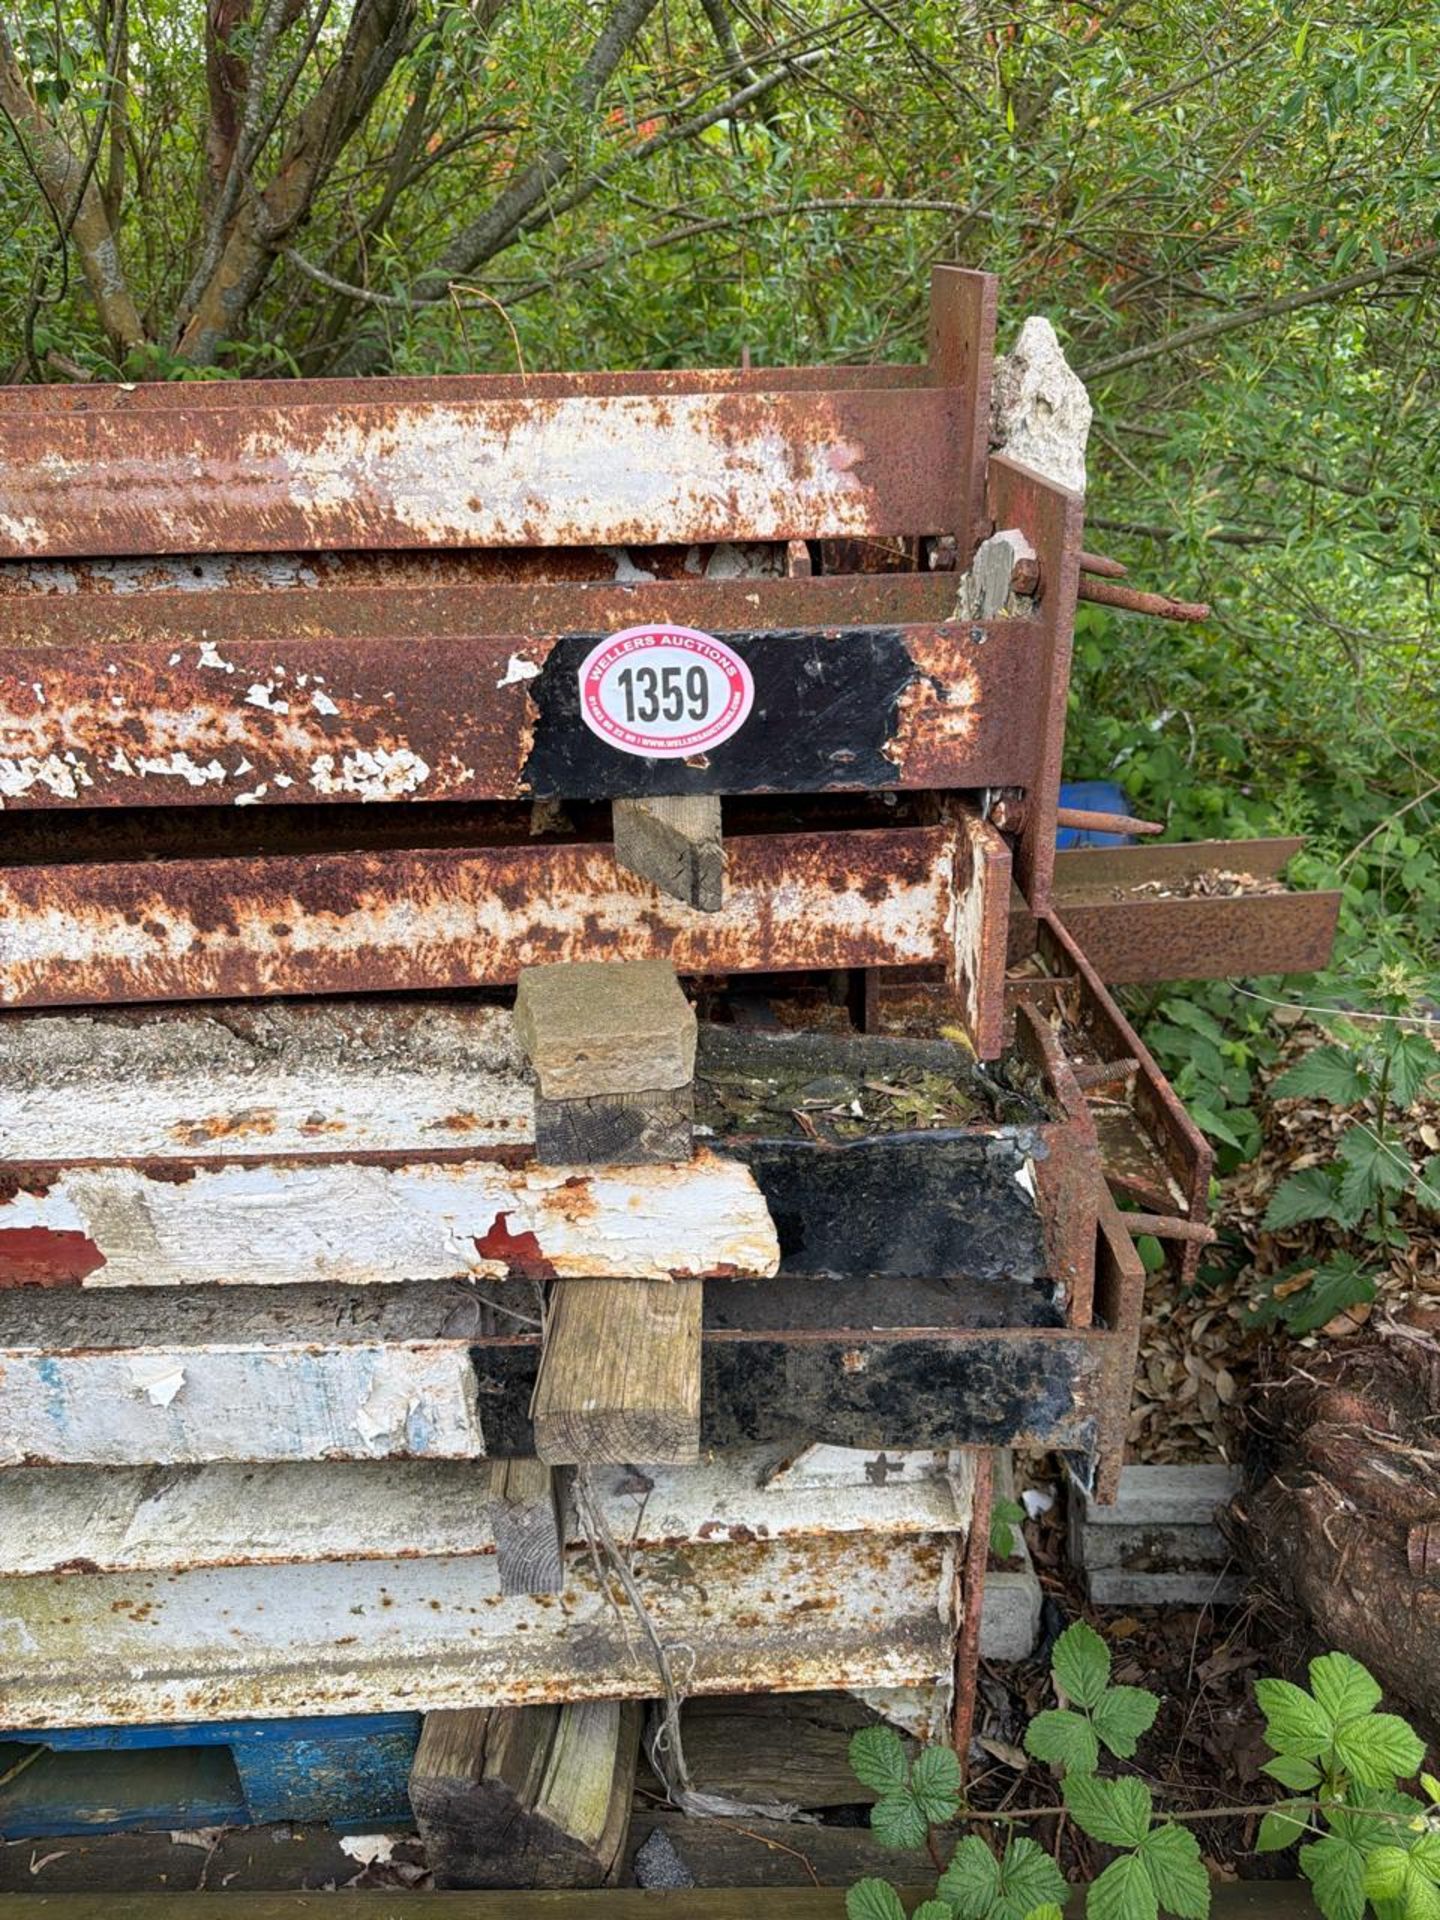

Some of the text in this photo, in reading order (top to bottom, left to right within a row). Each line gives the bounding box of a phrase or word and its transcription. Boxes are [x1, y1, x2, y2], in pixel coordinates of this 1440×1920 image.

[590, 636, 738, 680] WELLERS AUCTIONS
[618, 665, 709, 722] 1359
